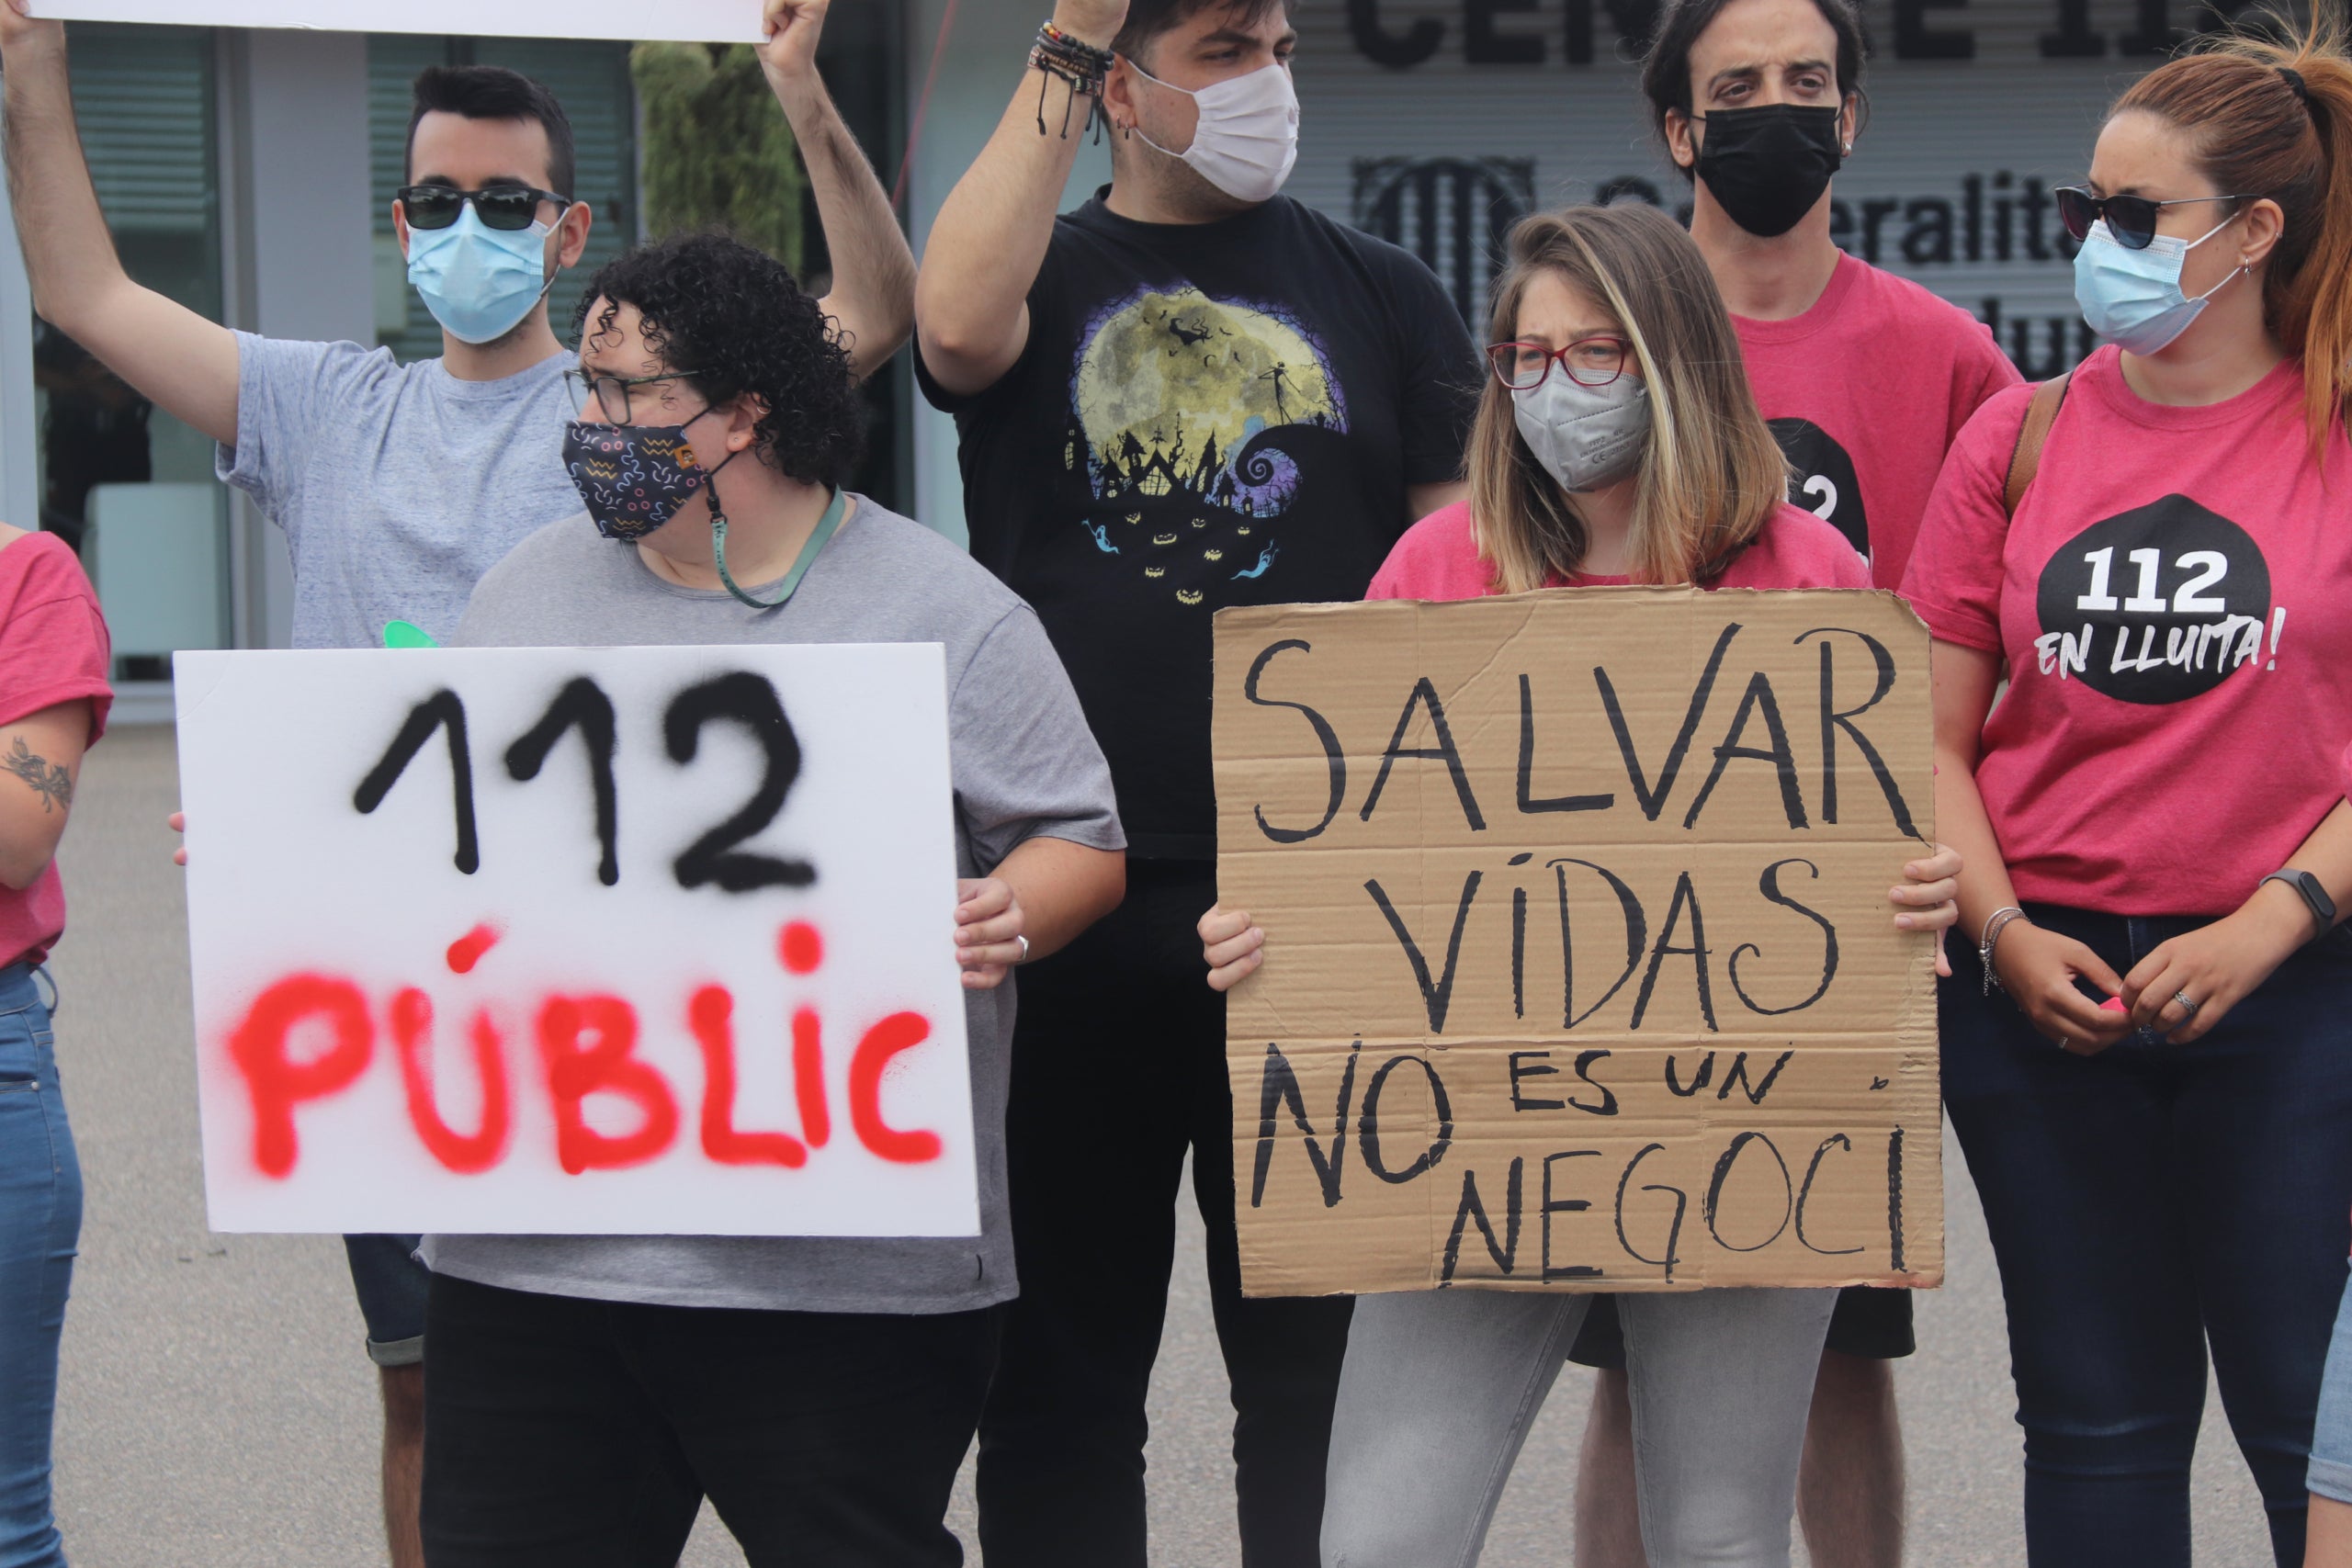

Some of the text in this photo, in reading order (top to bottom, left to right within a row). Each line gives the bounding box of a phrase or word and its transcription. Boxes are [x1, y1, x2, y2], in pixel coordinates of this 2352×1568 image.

[2033, 606, 2288, 680] EN LLUITA!
[2076, 546, 2229, 613] 112
[354, 671, 818, 892] 112
[1244, 622, 1931, 848] SALVAR
[1251, 1032, 1794, 1208] NO ES UN
[1437, 1123, 1908, 1288] NEGOCI
